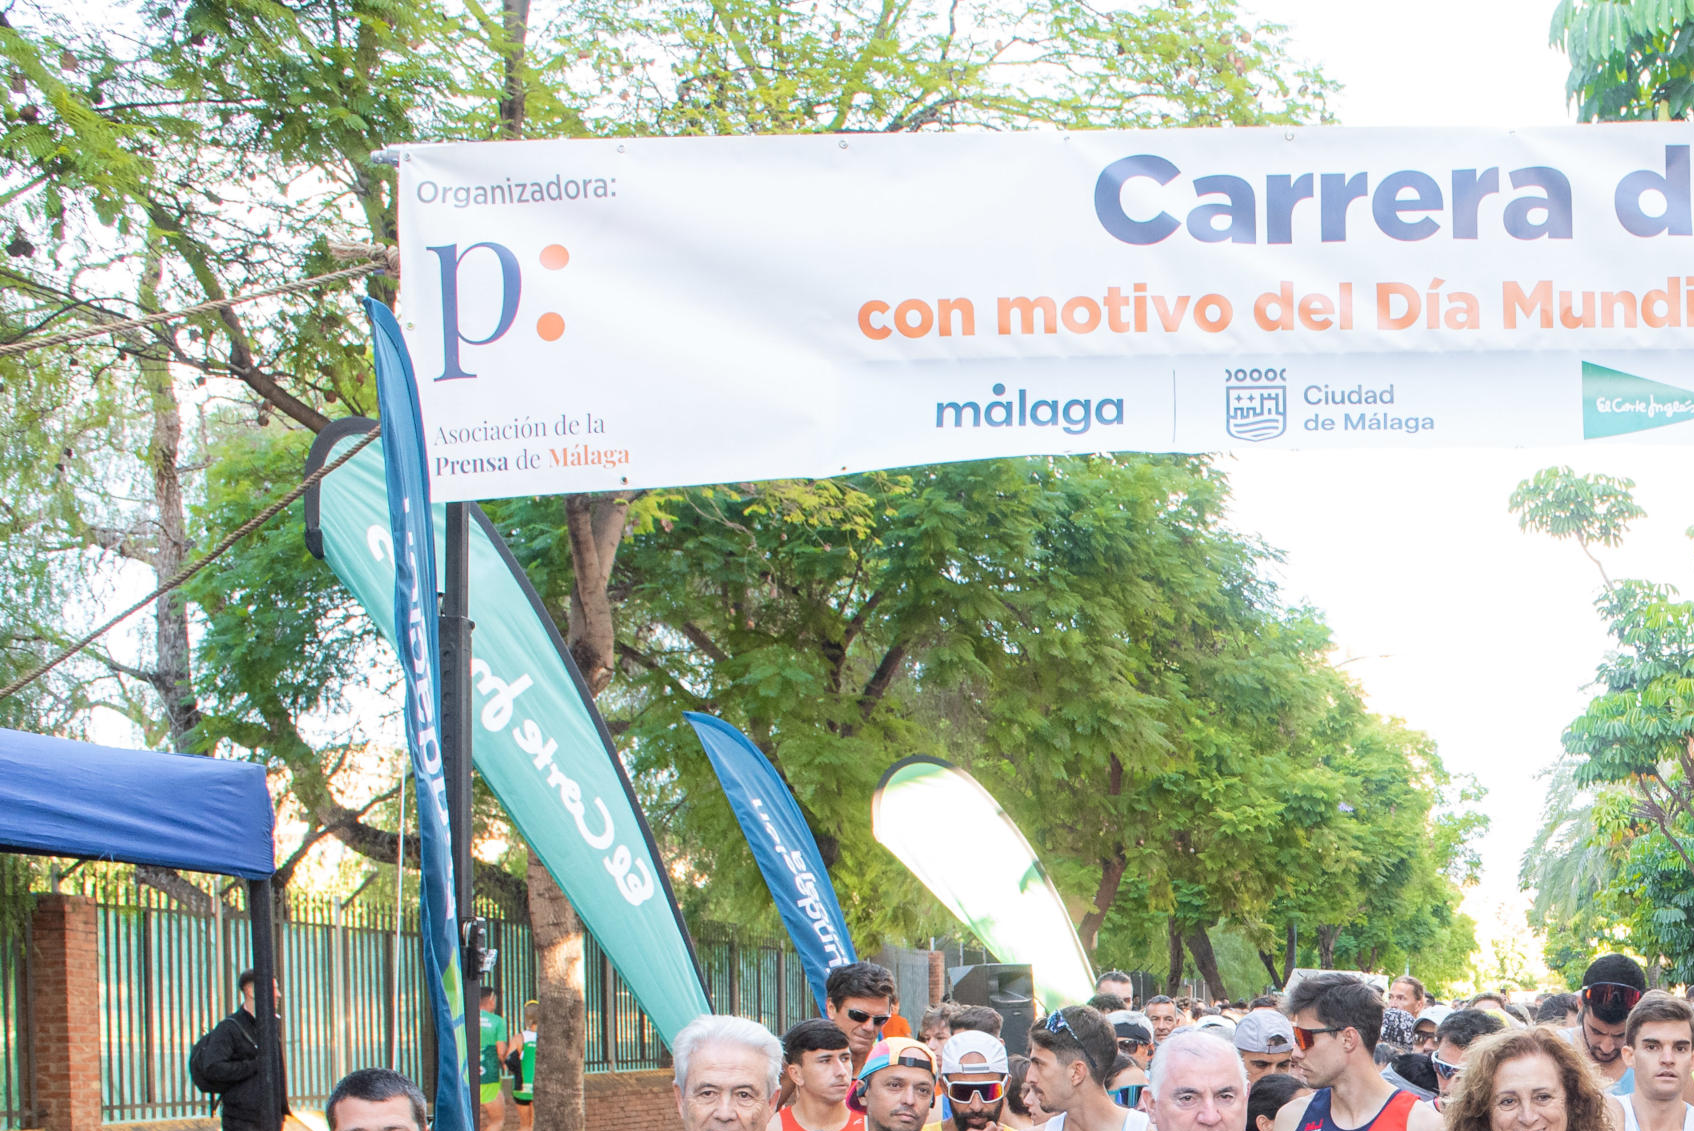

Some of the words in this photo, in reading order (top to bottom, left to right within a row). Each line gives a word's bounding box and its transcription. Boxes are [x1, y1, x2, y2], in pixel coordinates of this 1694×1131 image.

[416, 174, 617, 208] Organizadora:
[1094, 153, 1574, 245] Carrera
[857, 296, 976, 340] con
[997, 282, 1234, 336] motivo
[1253, 279, 1353, 331] del
[1376, 276, 1481, 331] Día
[1302, 385, 1395, 407] Ciudad
[1596, 397, 1613, 414] El
[1612, 397, 1649, 414] Corte
[434, 415, 547, 447] Asociación
[554, 413, 581, 437] de
[586, 412, 606, 434] la
[1302, 412, 1335, 432] de
[1342, 411, 1435, 434] Málaga
[435, 453, 509, 477] Prensa
[516, 448, 542, 472] de
[549, 444, 631, 469] Málaga
